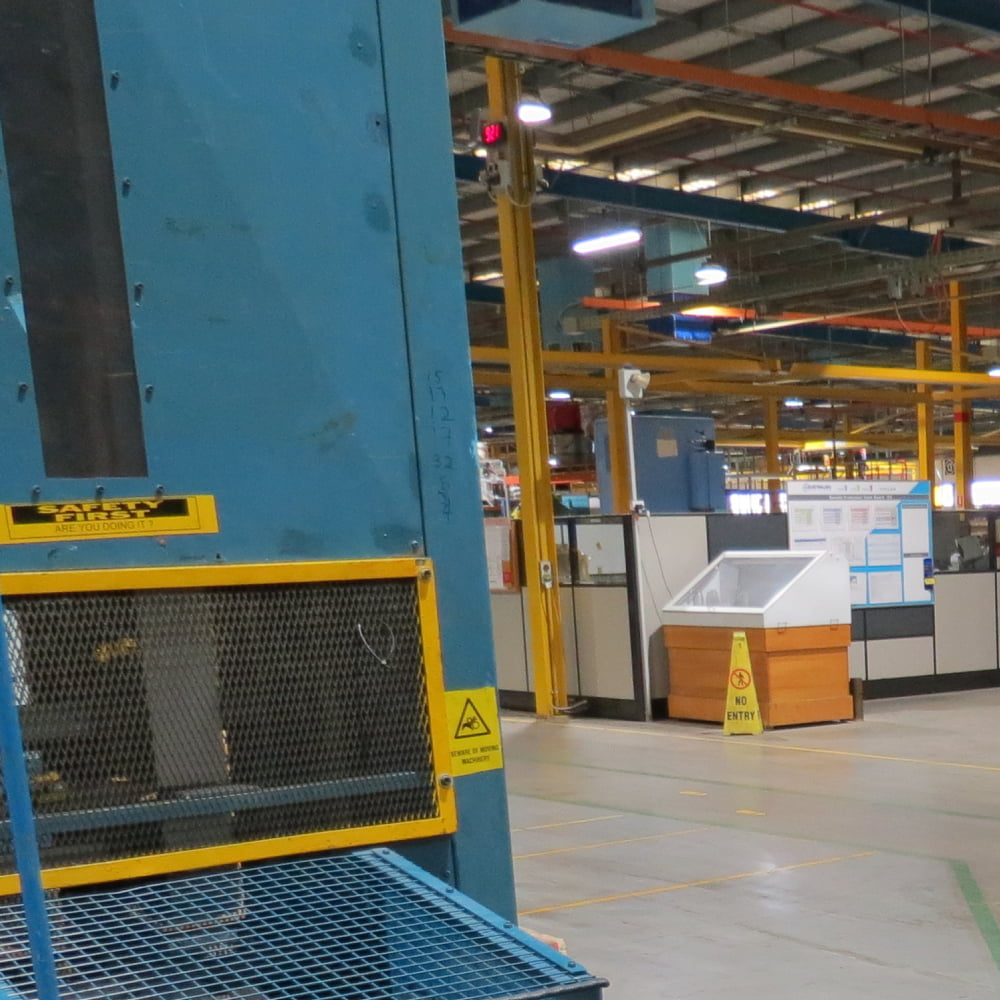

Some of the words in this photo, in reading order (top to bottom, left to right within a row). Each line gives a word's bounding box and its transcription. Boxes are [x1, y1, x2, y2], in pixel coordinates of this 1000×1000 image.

[37, 500, 164, 514] SAFETY
[54, 510, 150, 522] FIRST
[55, 523, 75, 533] ARE
[79, 521, 100, 532] YOU
[103, 519, 134, 531] DOING
[137, 519, 146, 529] IT
[735, 696, 747, 705] NO
[727, 711, 755, 720] ENTRY
